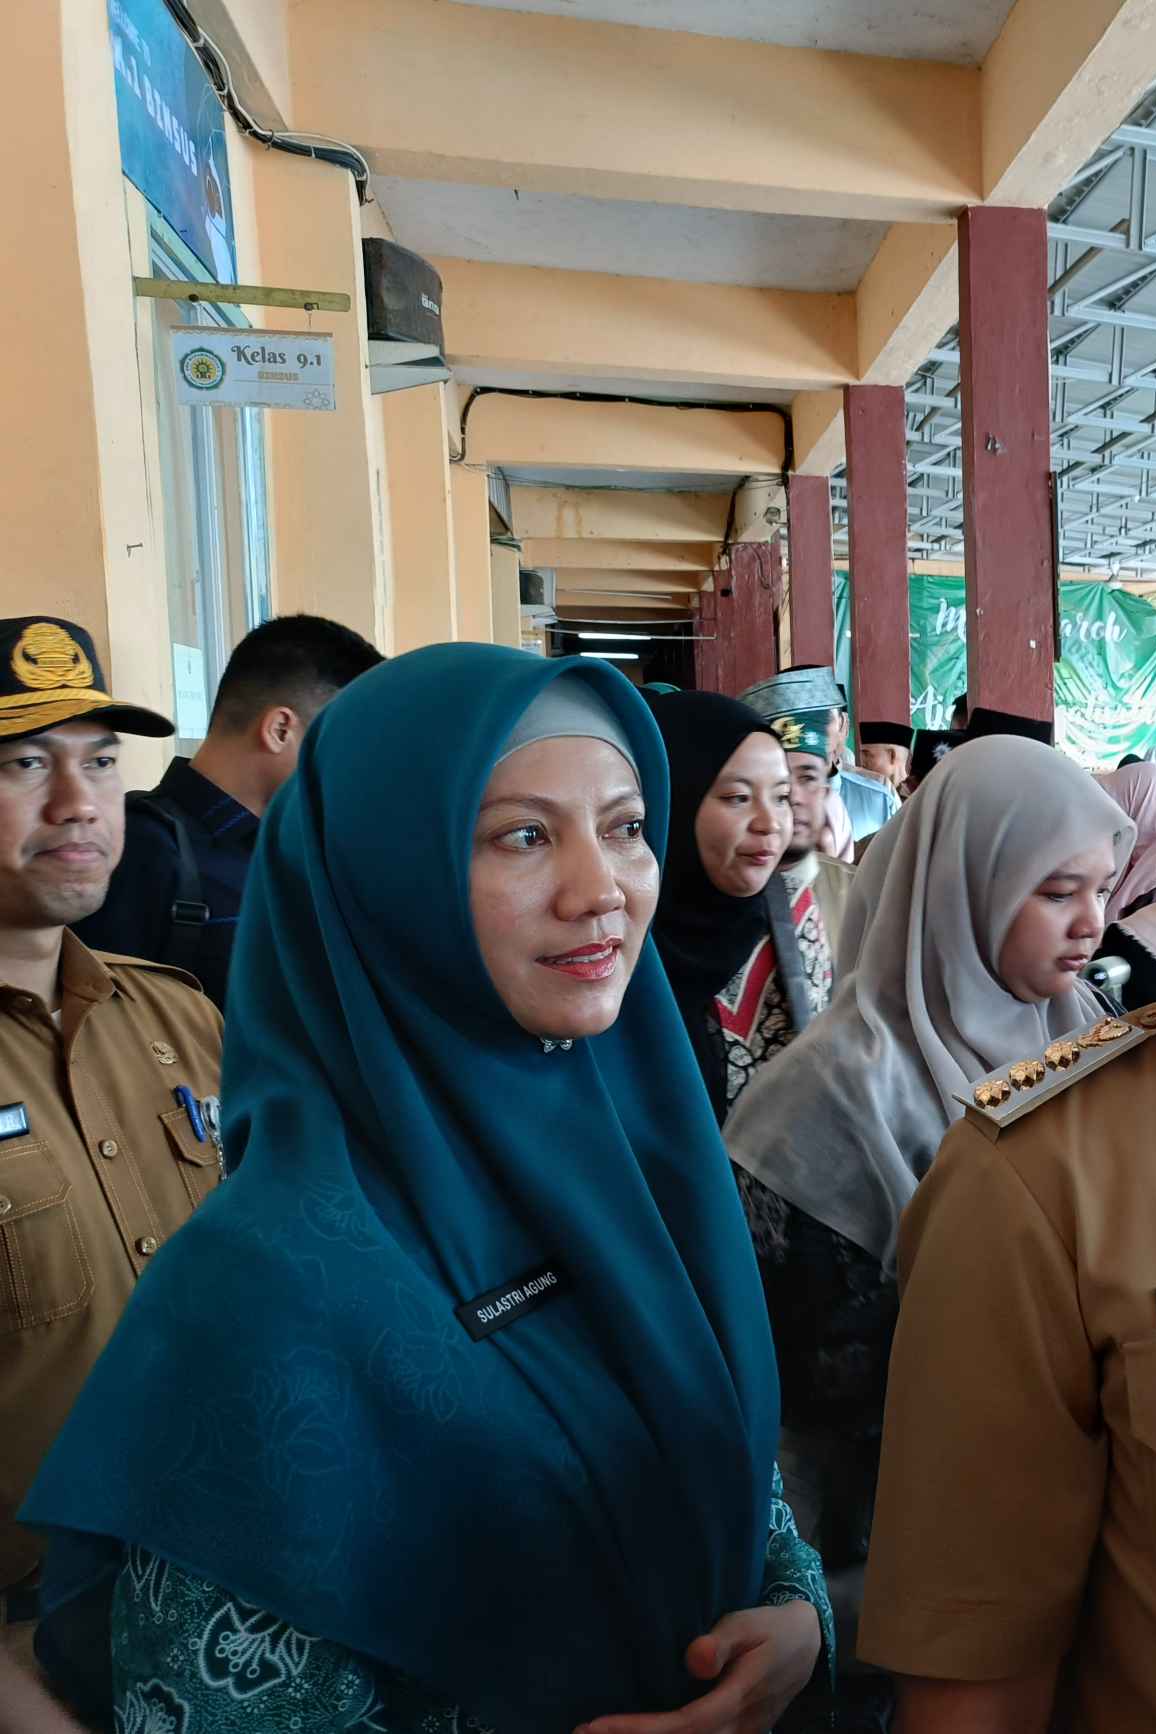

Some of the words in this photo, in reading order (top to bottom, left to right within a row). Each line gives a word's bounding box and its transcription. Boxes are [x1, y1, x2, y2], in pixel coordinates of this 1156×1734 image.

[231, 344, 287, 366] Kelas
[296, 353, 322, 369] 9.1
[476, 1288, 526, 1324] SULASTRI
[523, 1271, 558, 1299] AGUNG
